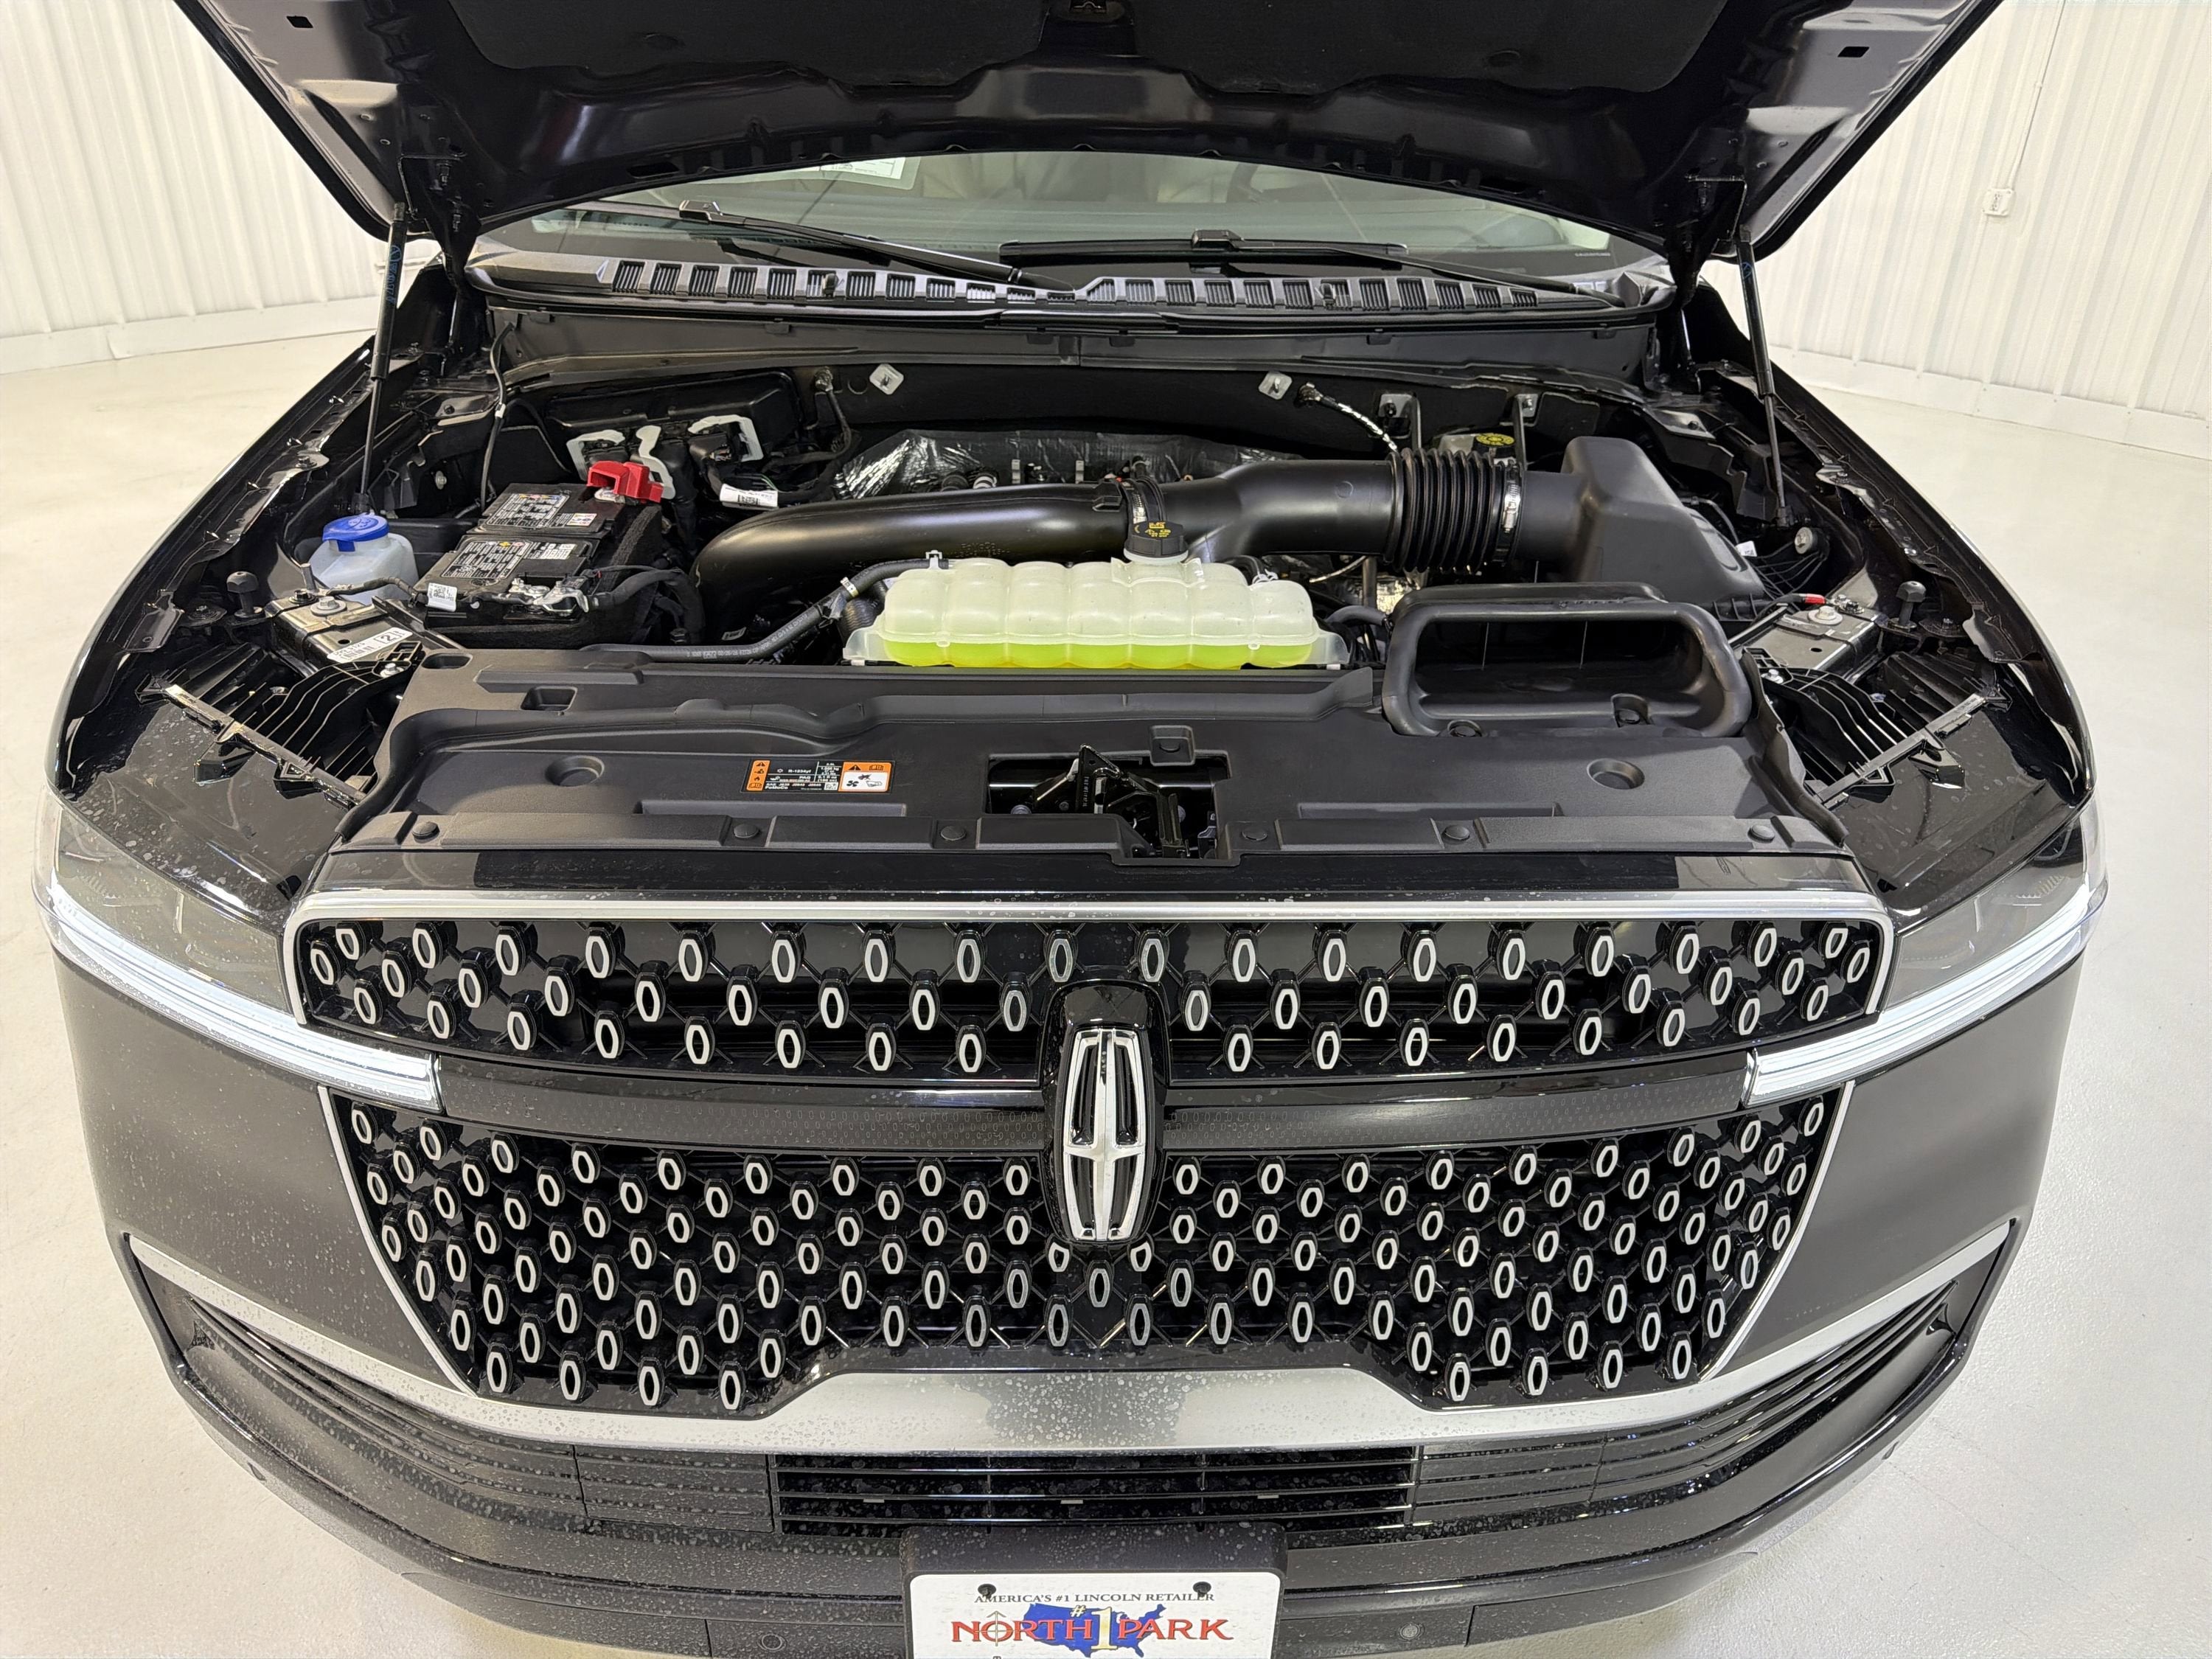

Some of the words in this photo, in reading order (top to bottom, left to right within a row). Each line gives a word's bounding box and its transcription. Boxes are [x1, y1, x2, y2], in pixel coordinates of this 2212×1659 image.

[974, 1594, 1051, 1603] AMERICA'S
[1074, 1593, 1141, 1602] LINCOLN
[1145, 1593, 1215, 1601] RETAILER
[951, 1618, 1093, 1642] NORTH
[1118, 1618, 1234, 1641] PARK
